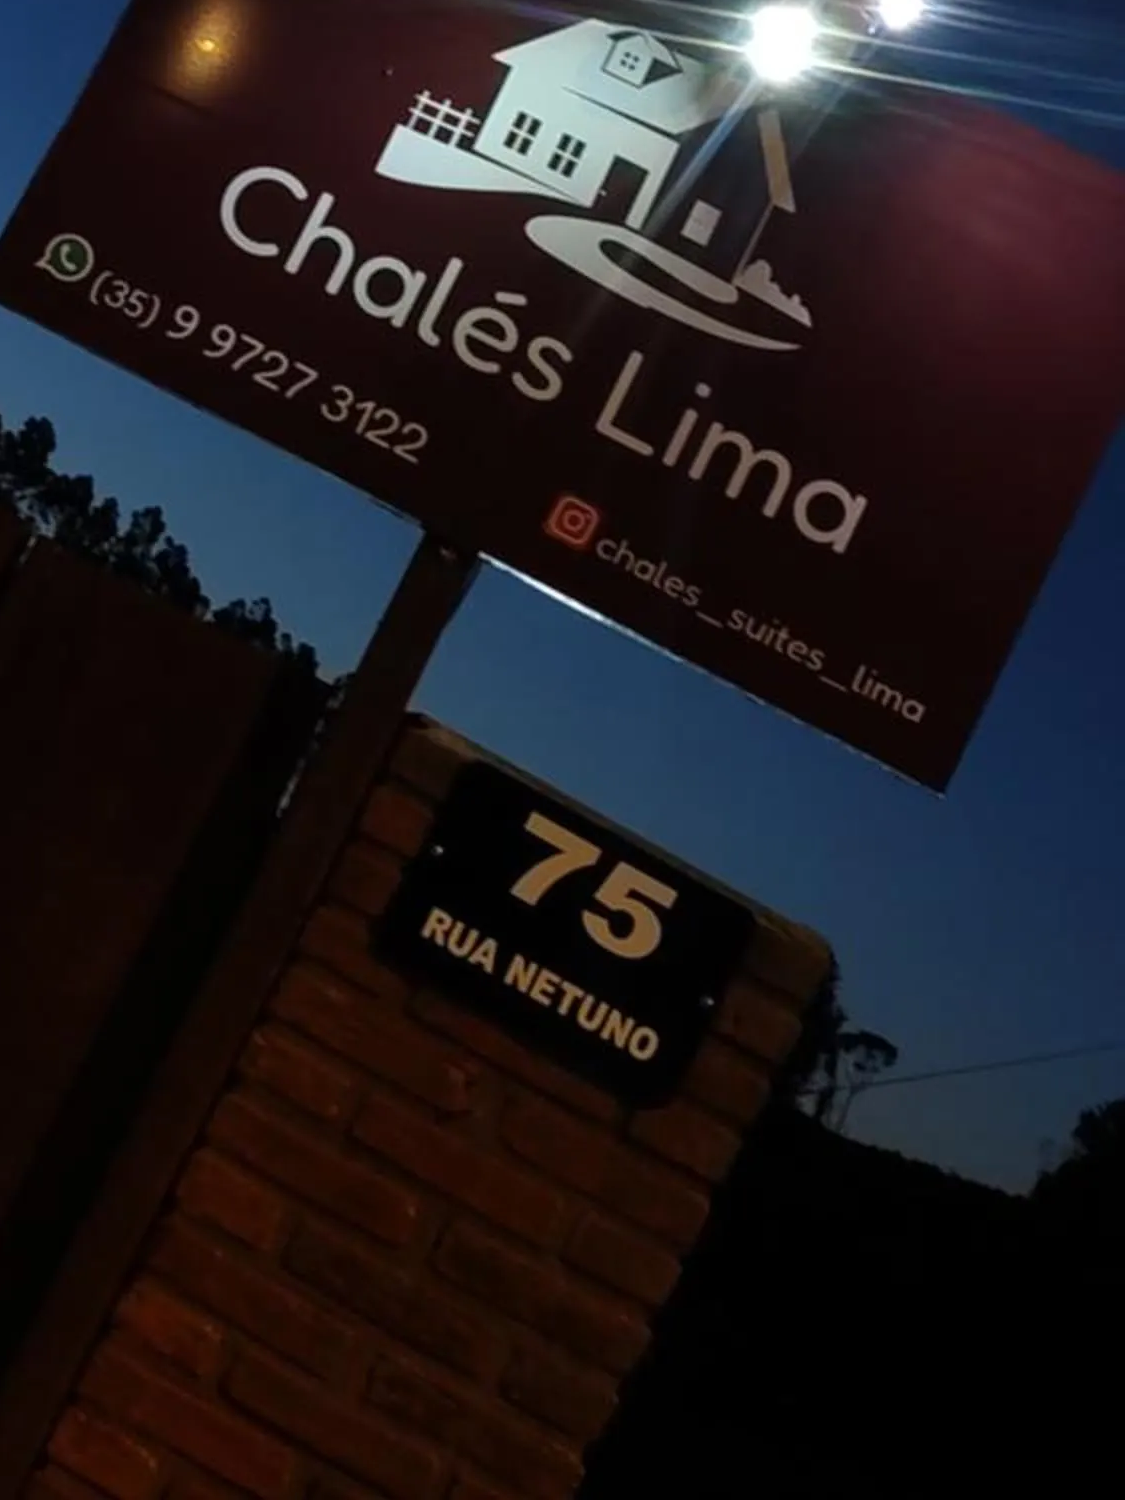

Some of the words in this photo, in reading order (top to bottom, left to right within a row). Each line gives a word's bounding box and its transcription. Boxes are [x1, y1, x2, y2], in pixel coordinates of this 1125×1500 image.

[89, 271, 160, 329] (35)
[166, 304, 200, 339] 9
[203, 323, 319, 399] 9727
[320, 383, 429, 464] 3122
[219, 165, 573, 400] Chalés
[596, 351, 868, 553] Lima
[596, 536, 926, 723] chales_suites_lima
[510, 811, 678, 960] 75
[420, 906, 499, 974] RUA
[503, 953, 659, 1061] NETUNO
